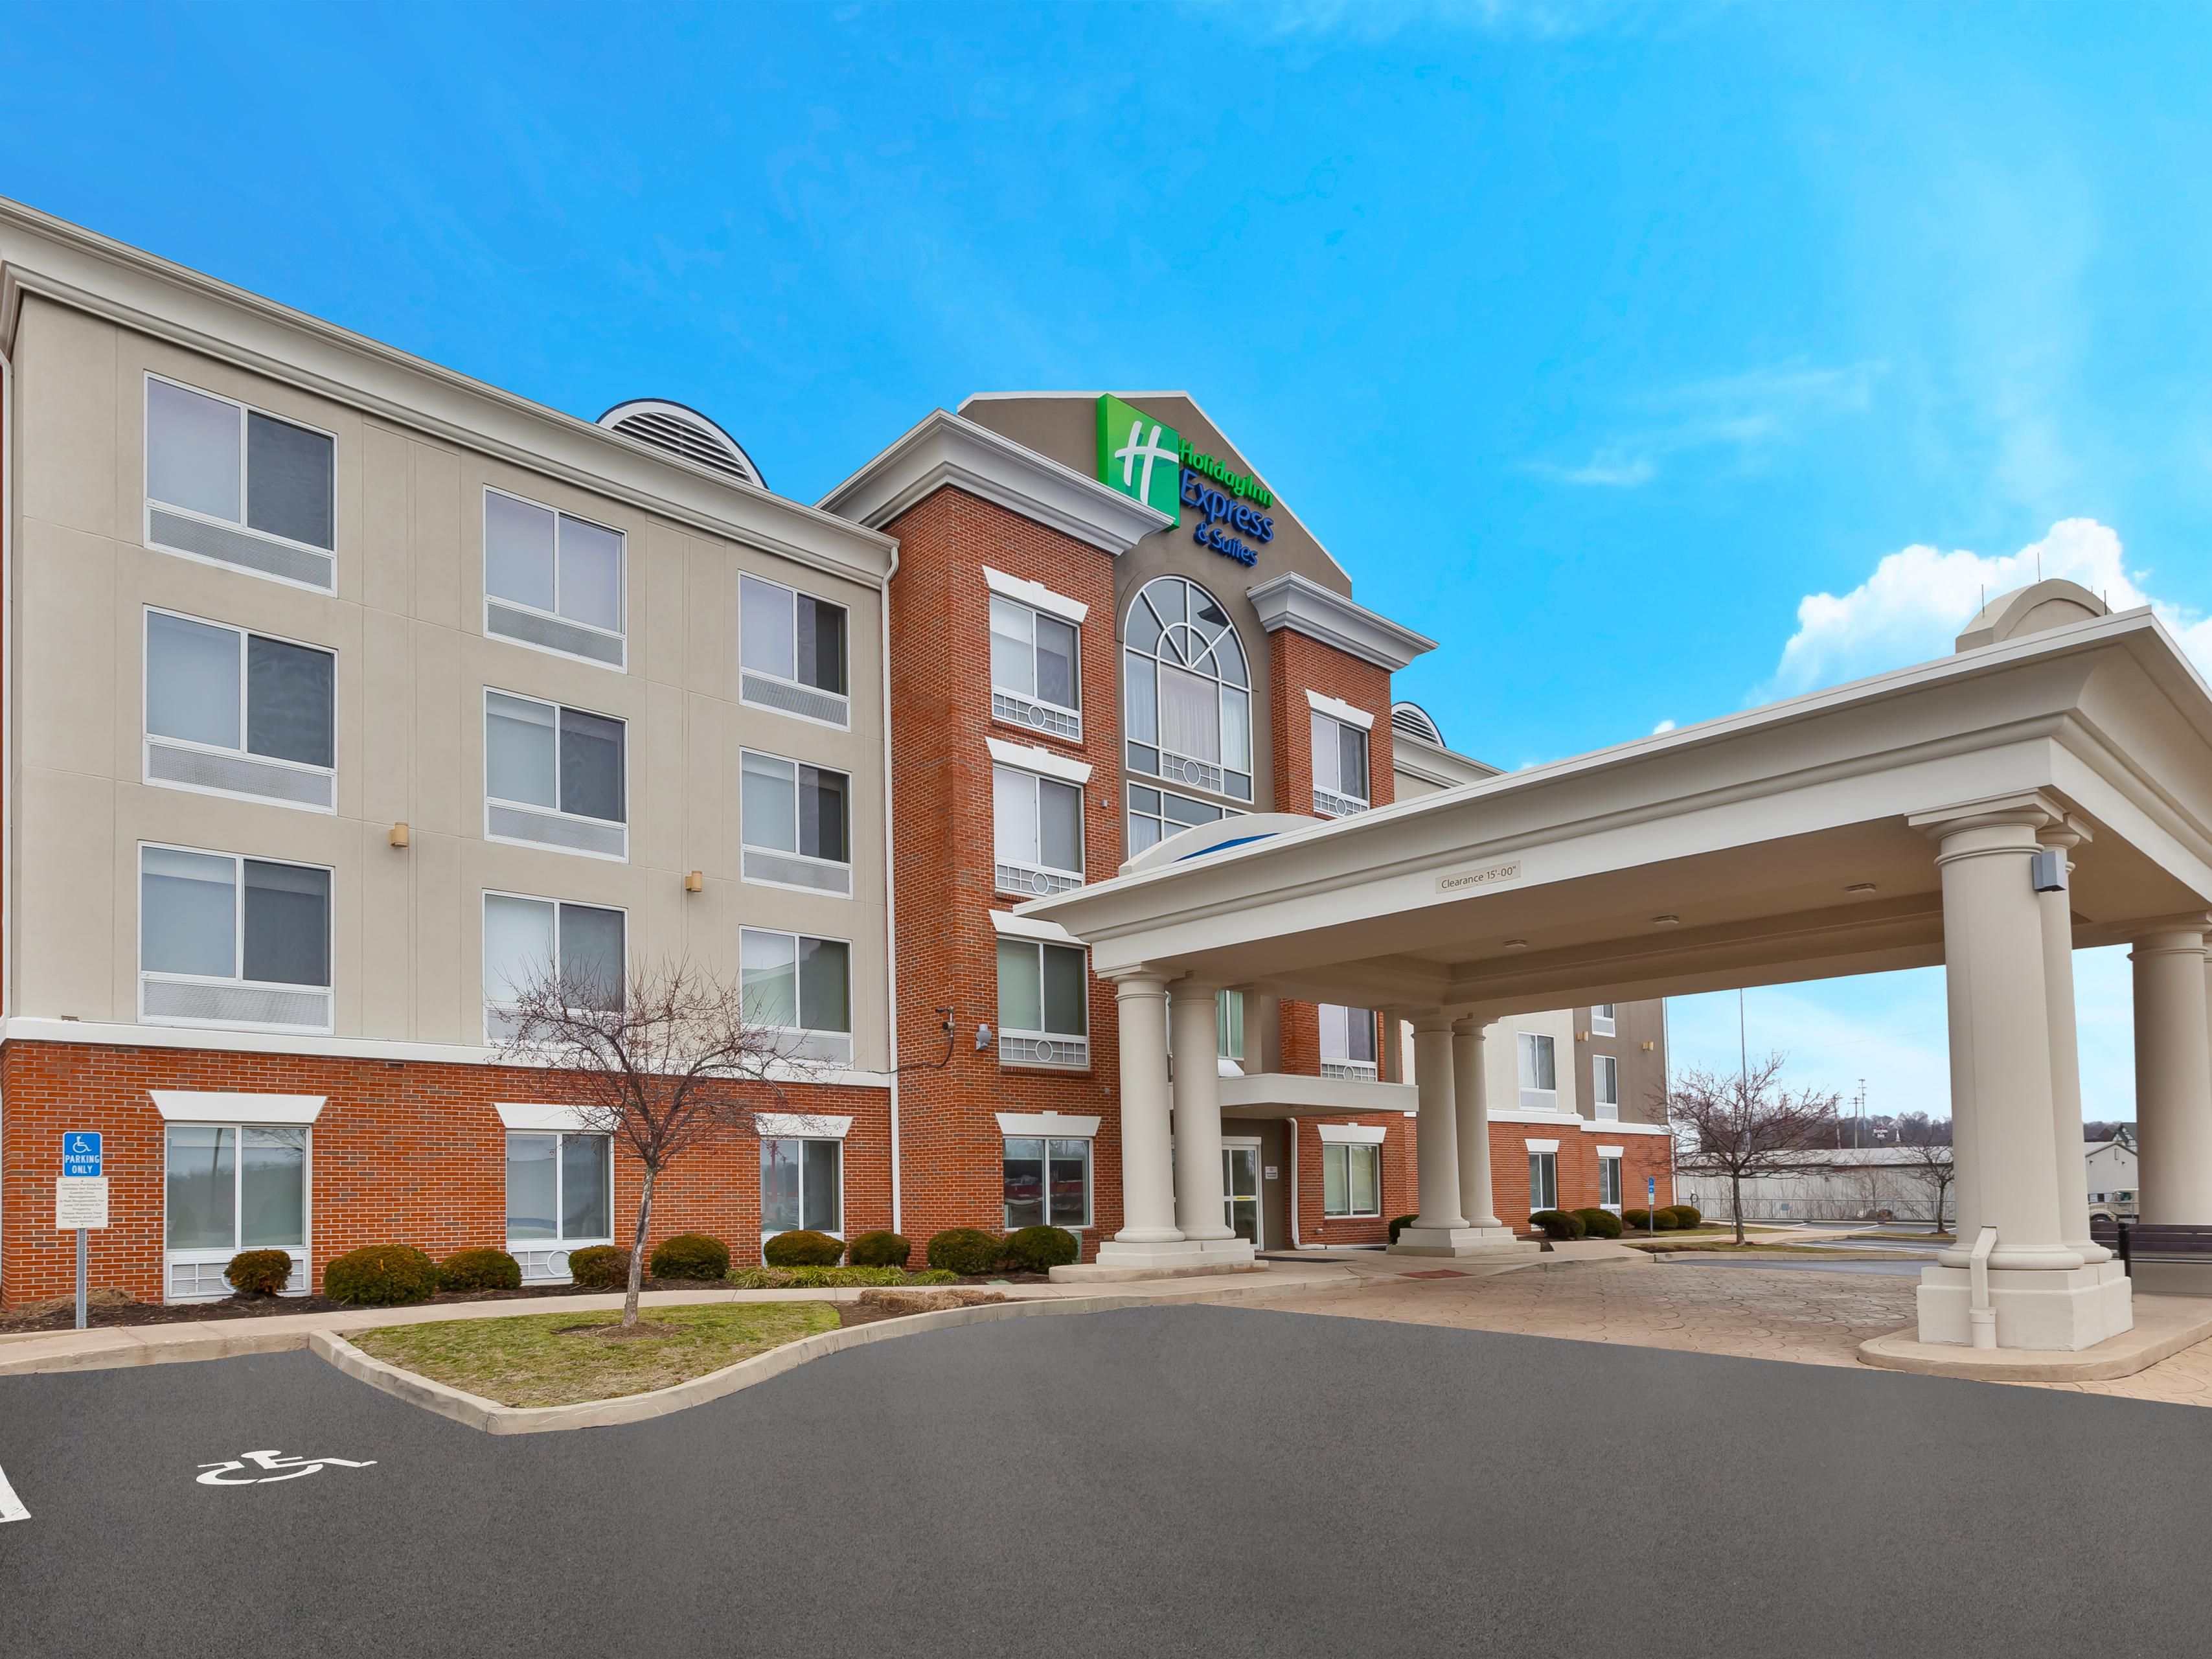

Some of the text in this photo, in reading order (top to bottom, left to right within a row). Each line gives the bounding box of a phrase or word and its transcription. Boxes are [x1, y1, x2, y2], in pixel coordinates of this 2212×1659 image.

[1179, 439, 1273, 509] Holiday Inn
[1180, 468, 1274, 543] Express
[1194, 522, 1258, 567] & Suites
[1441, 874, 1484, 889] Clearance
[65, 1154, 100, 1163] PARKING
[72, 1165, 93, 1174] ONLY
